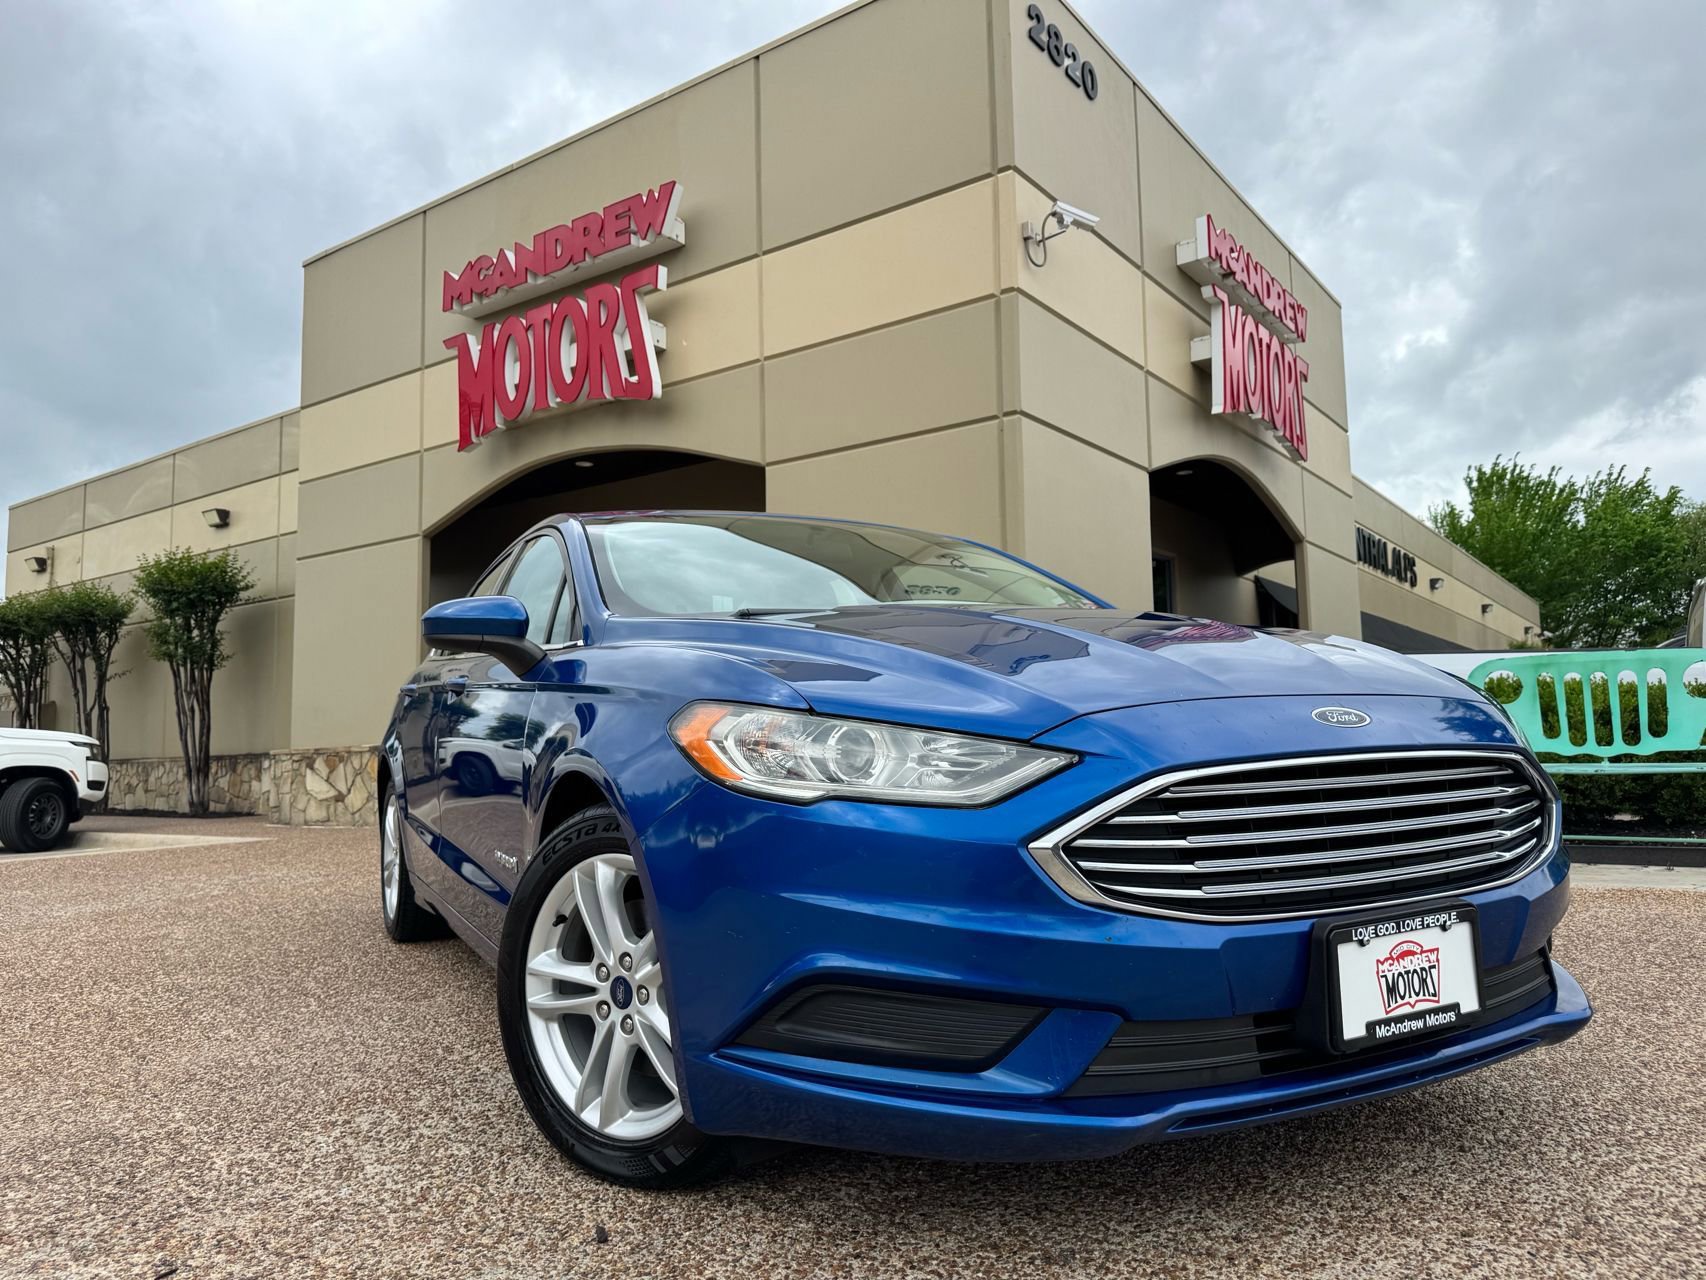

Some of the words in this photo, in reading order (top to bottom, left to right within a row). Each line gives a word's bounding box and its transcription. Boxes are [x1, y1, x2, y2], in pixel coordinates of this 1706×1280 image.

[1027, 3, 1098, 101] 2820
[442, 264, 660, 452] MOTORS
[1211, 283, 1309, 462] MOTORS
[1326, 710, 1359, 722] Ford
[1352, 926, 1376, 941] LOVE
[1377, 922, 1399, 936] GOD.
[1400, 917, 1423, 932] LOVE
[1424, 912, 1460, 928] PEOPLE.
[1380, 964, 1438, 1009] MOTORS
[1375, 1017, 1424, 1039] McAndrew
[1426, 1011, 1456, 1026] Motors
